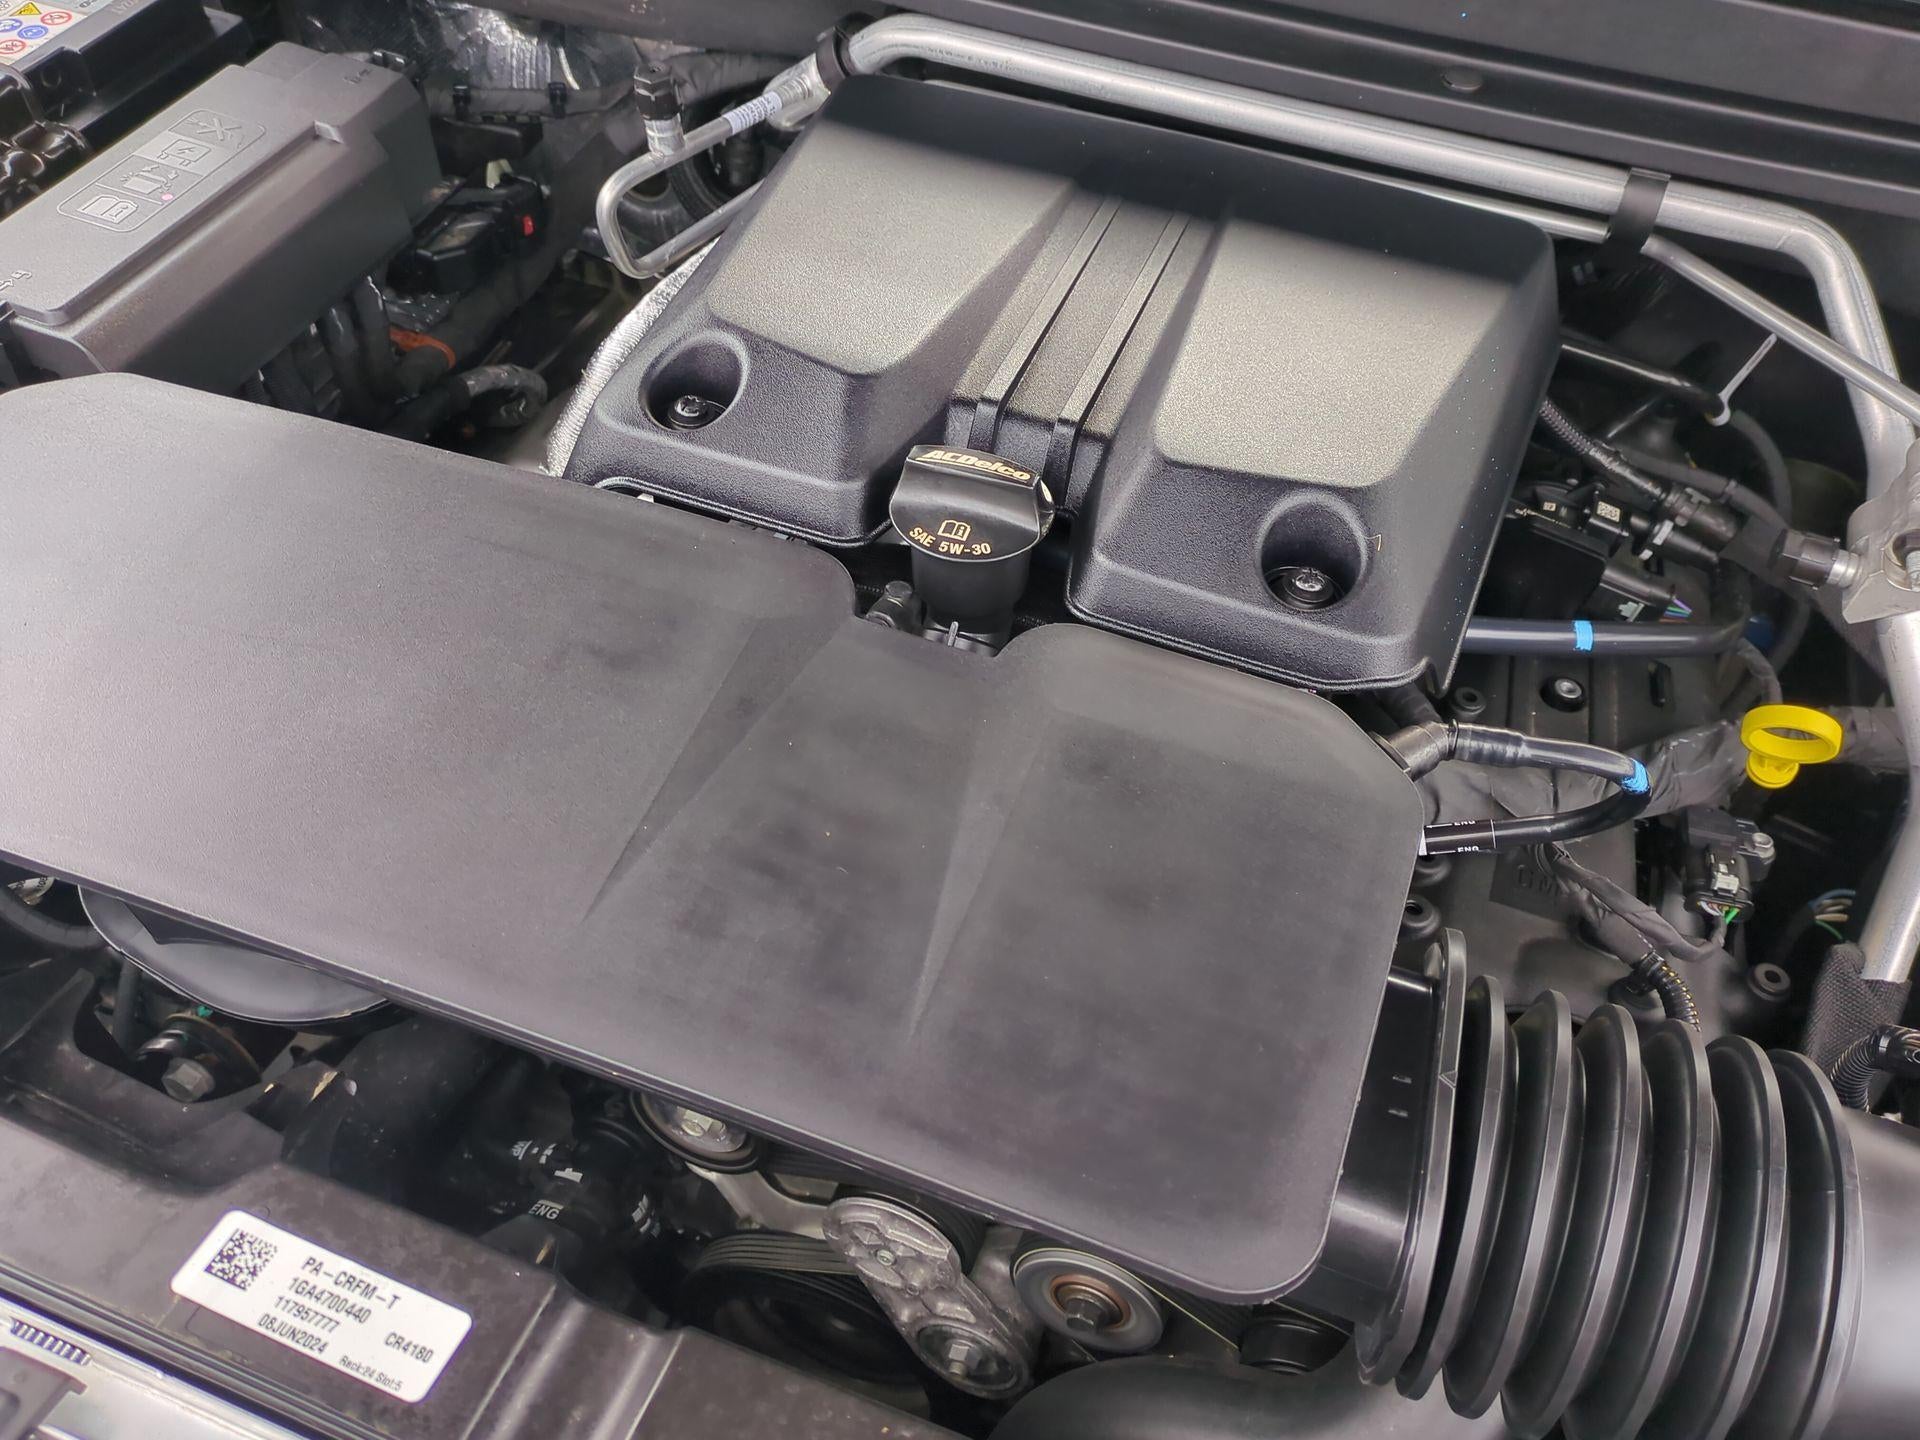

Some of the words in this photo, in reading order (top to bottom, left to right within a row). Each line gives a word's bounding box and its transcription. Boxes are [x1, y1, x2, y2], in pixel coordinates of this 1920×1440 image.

[922, 449, 1032, 482] ACDelco
[909, 526, 937, 548] SAE
[938, 541, 992, 556] 5W-30
[528, 1203, 560, 1220] ENG
[287, 1276, 372, 1324] 1GA4700440
[301, 1256, 402, 1310] PA-CRFM-T
[274, 1296, 340, 1333] 117957777
[258, 1313, 329, 1354] 08JUN2024
[384, 1332, 434, 1363] CR4180
